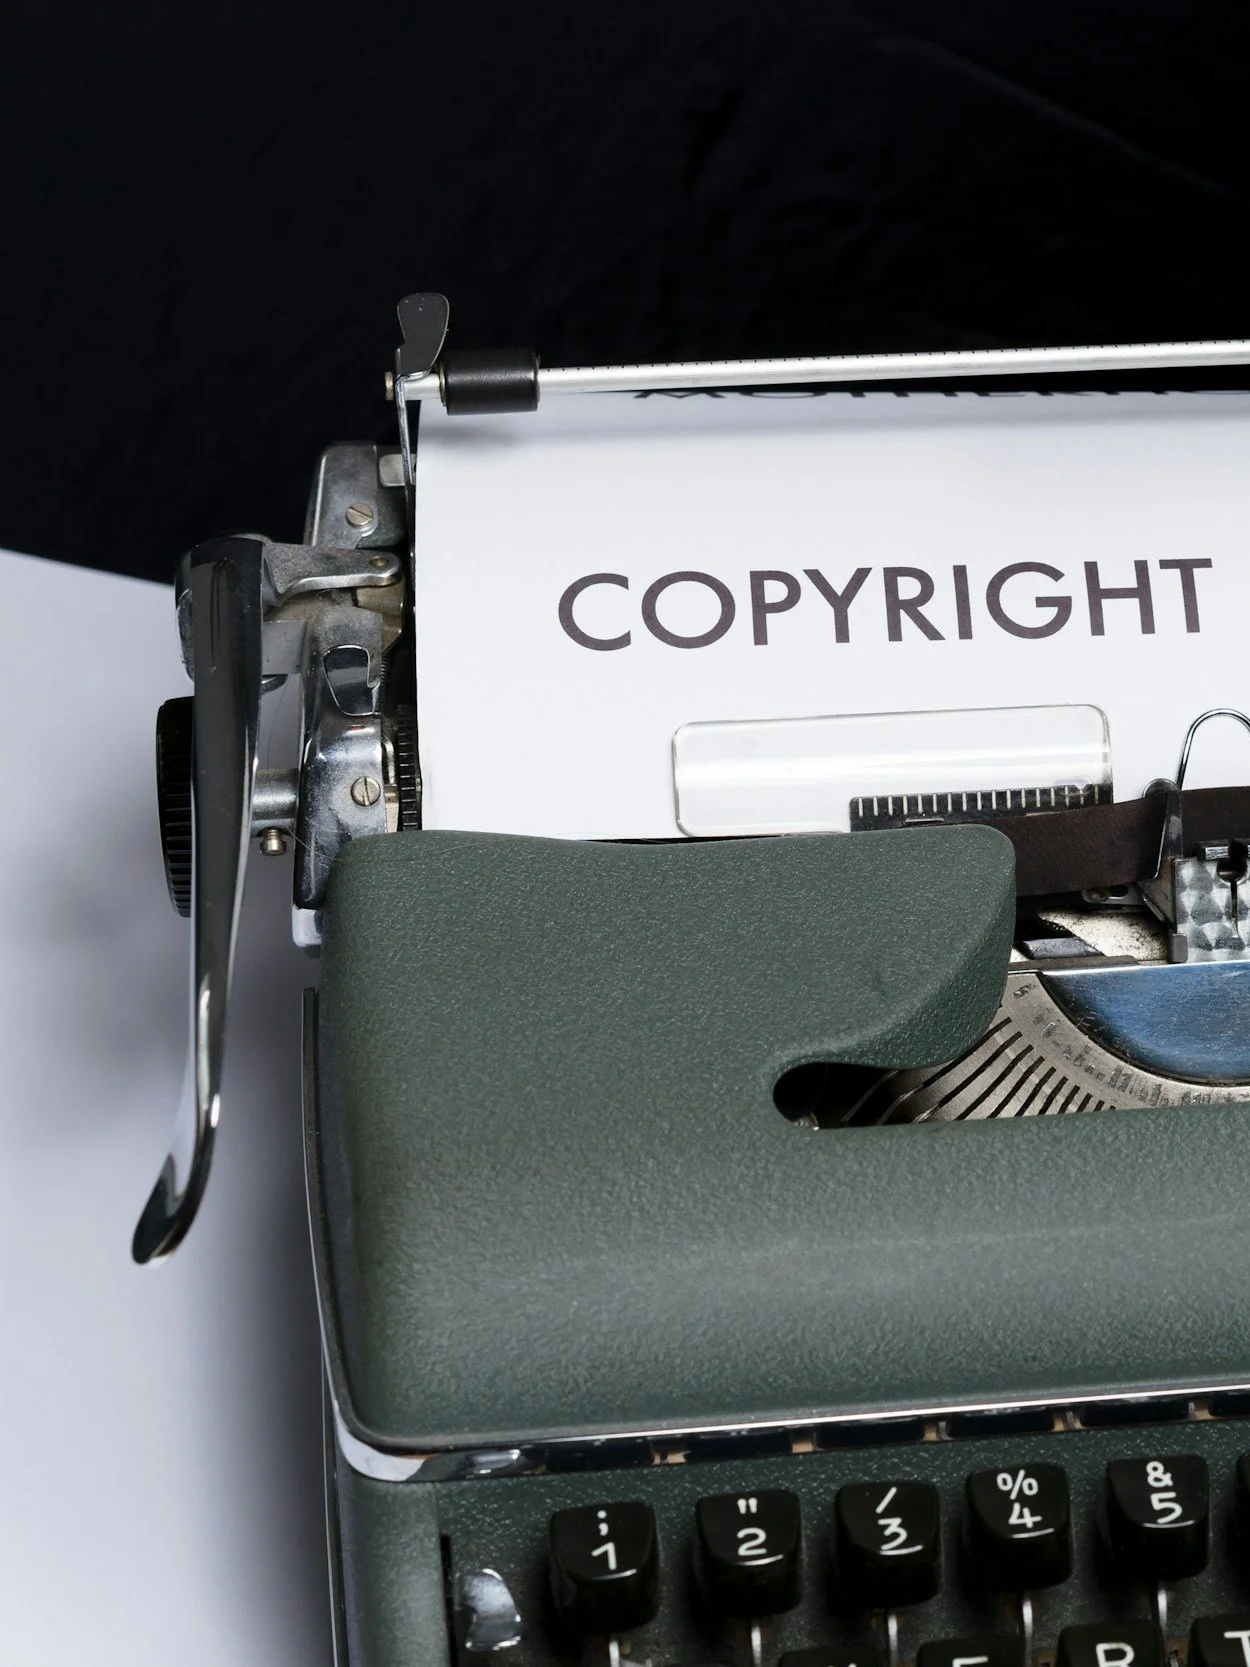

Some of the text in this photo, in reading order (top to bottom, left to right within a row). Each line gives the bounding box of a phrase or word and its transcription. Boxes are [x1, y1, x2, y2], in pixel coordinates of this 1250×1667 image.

[558, 557, 1213, 652] COPYRIGHT
[996, 1469, 1039, 1500] %
[1145, 1460, 1174, 1488] &
[875, 1486, 897, 1514] /
[1150, 1491, 1183, 1524] 5
[1008, 1502, 1042, 1529] 4
[736, 1527, 767, 1556] 2
[880, 1517, 908, 1551] 3
[591, 1541, 617, 1570] 1
